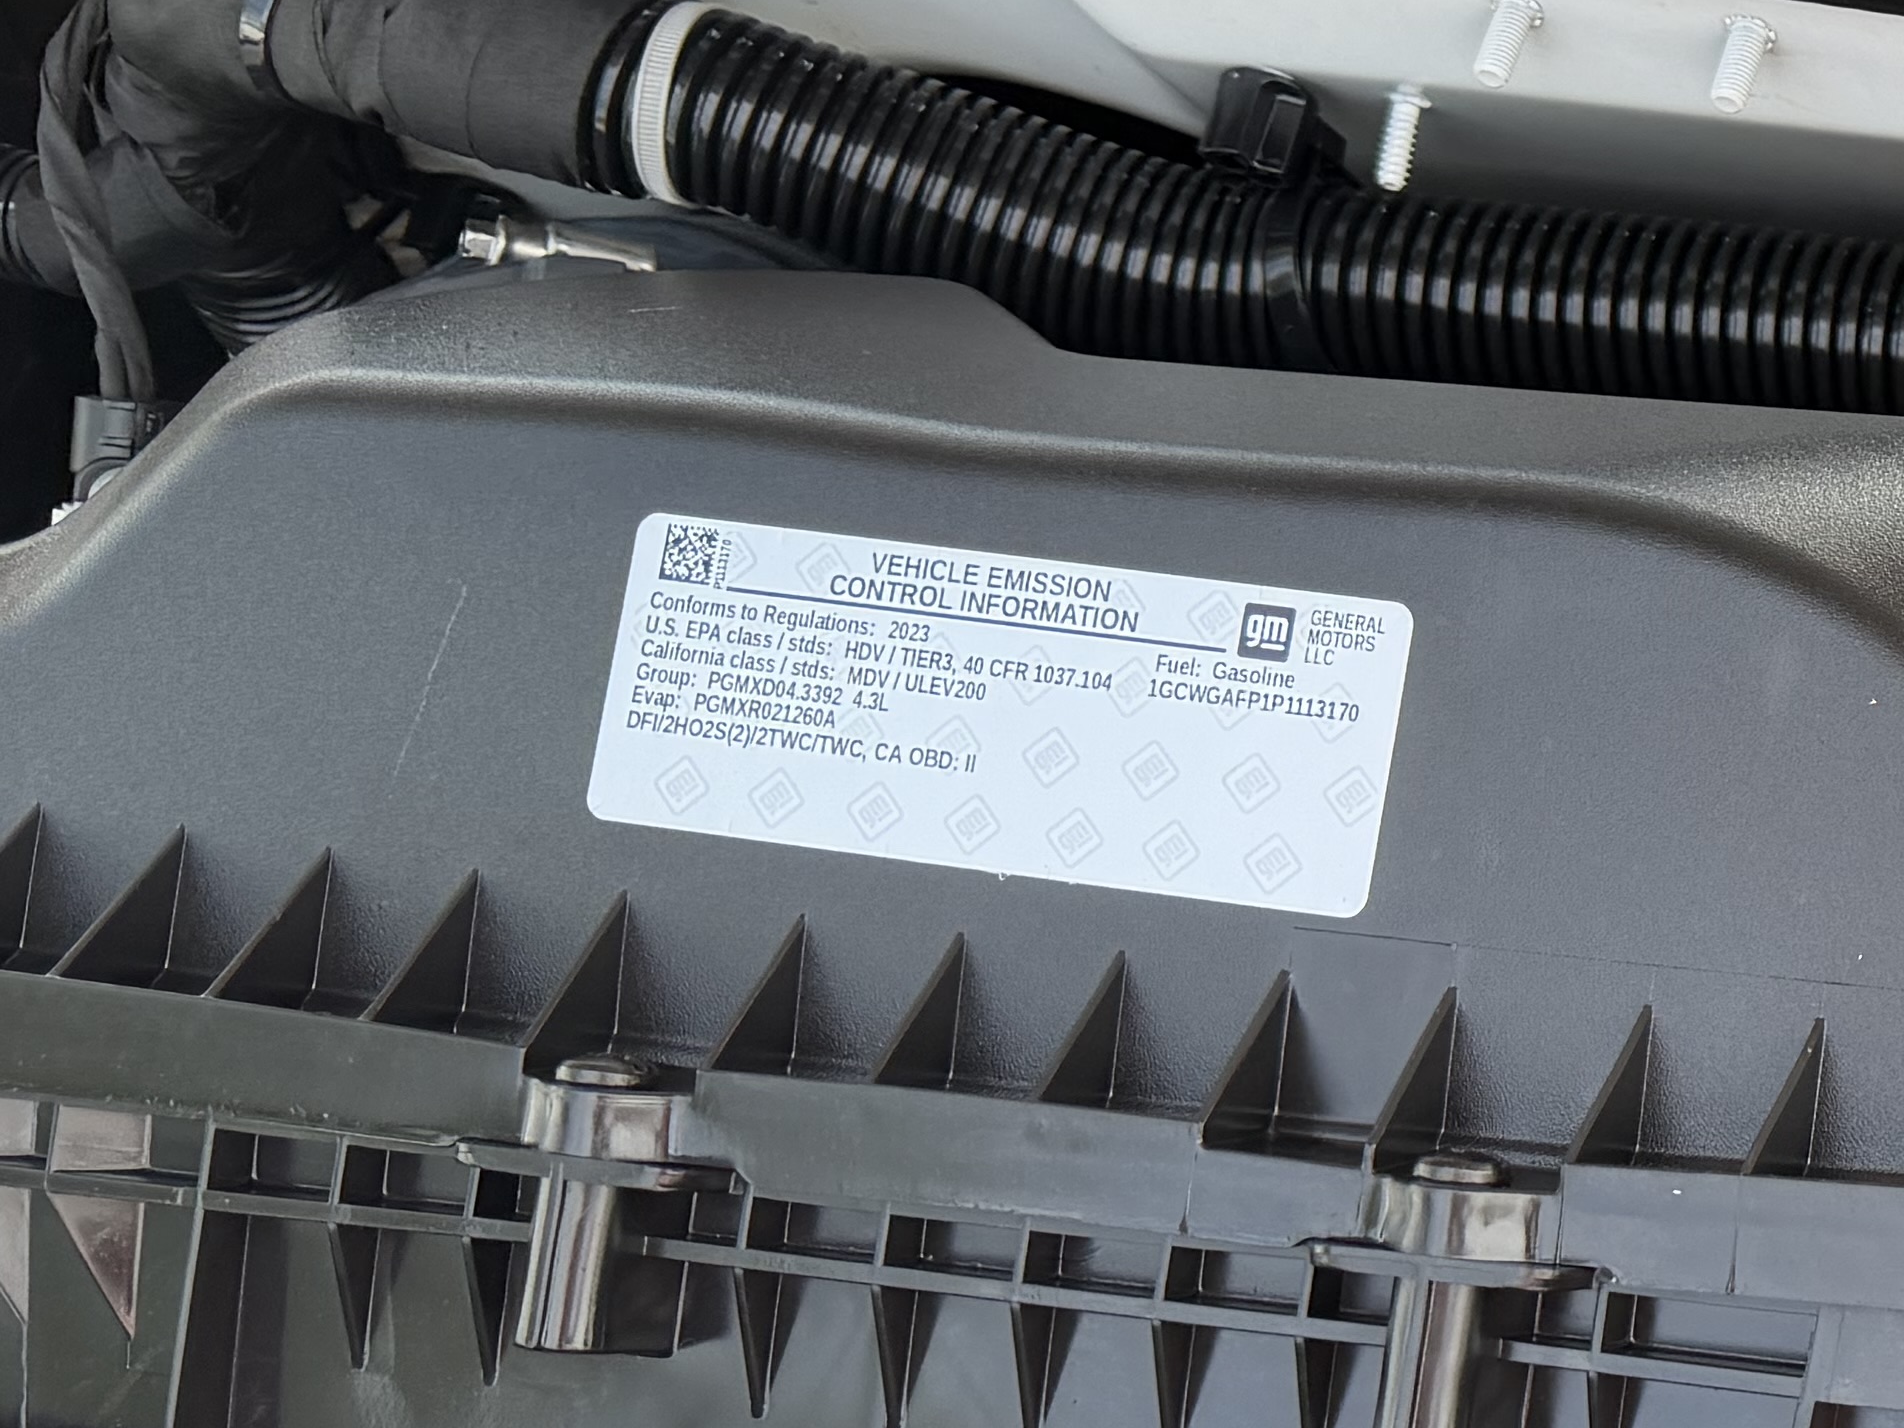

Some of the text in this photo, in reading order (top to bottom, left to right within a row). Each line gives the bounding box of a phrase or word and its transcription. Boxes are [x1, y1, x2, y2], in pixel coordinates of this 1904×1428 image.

[872, 552, 1112, 602] VEHICLE EMISSION
[650, 591, 931, 642] Conforms to Regulations: 2023
[829, 575, 1139, 633] CONTROL INFORMATION
[1311, 609, 1386, 634] GENERAL
[646, 615, 1113, 692] U.S. EPA class / stds: HDV / TIER3, 40 CFR 1037.104
[1246, 614, 1290, 651] gm
[1307, 629, 1376, 652] MOTORS
[641, 639, 987, 701] California class / stds: MDV / ULEV200
[1155, 653, 1295, 689] Fuel: Gasoline
[1304, 647, 1335, 666] LLC
[631, 685, 836, 728] Evap: PGMXR021260A
[636, 662, 889, 712] Group: PGMXD04.3392 4.3L
[1148, 678, 1360, 722] 1GCWGAFP1P1113170
[875, 742, 902, 764] CA
[909, 747, 960, 771] OBD:
